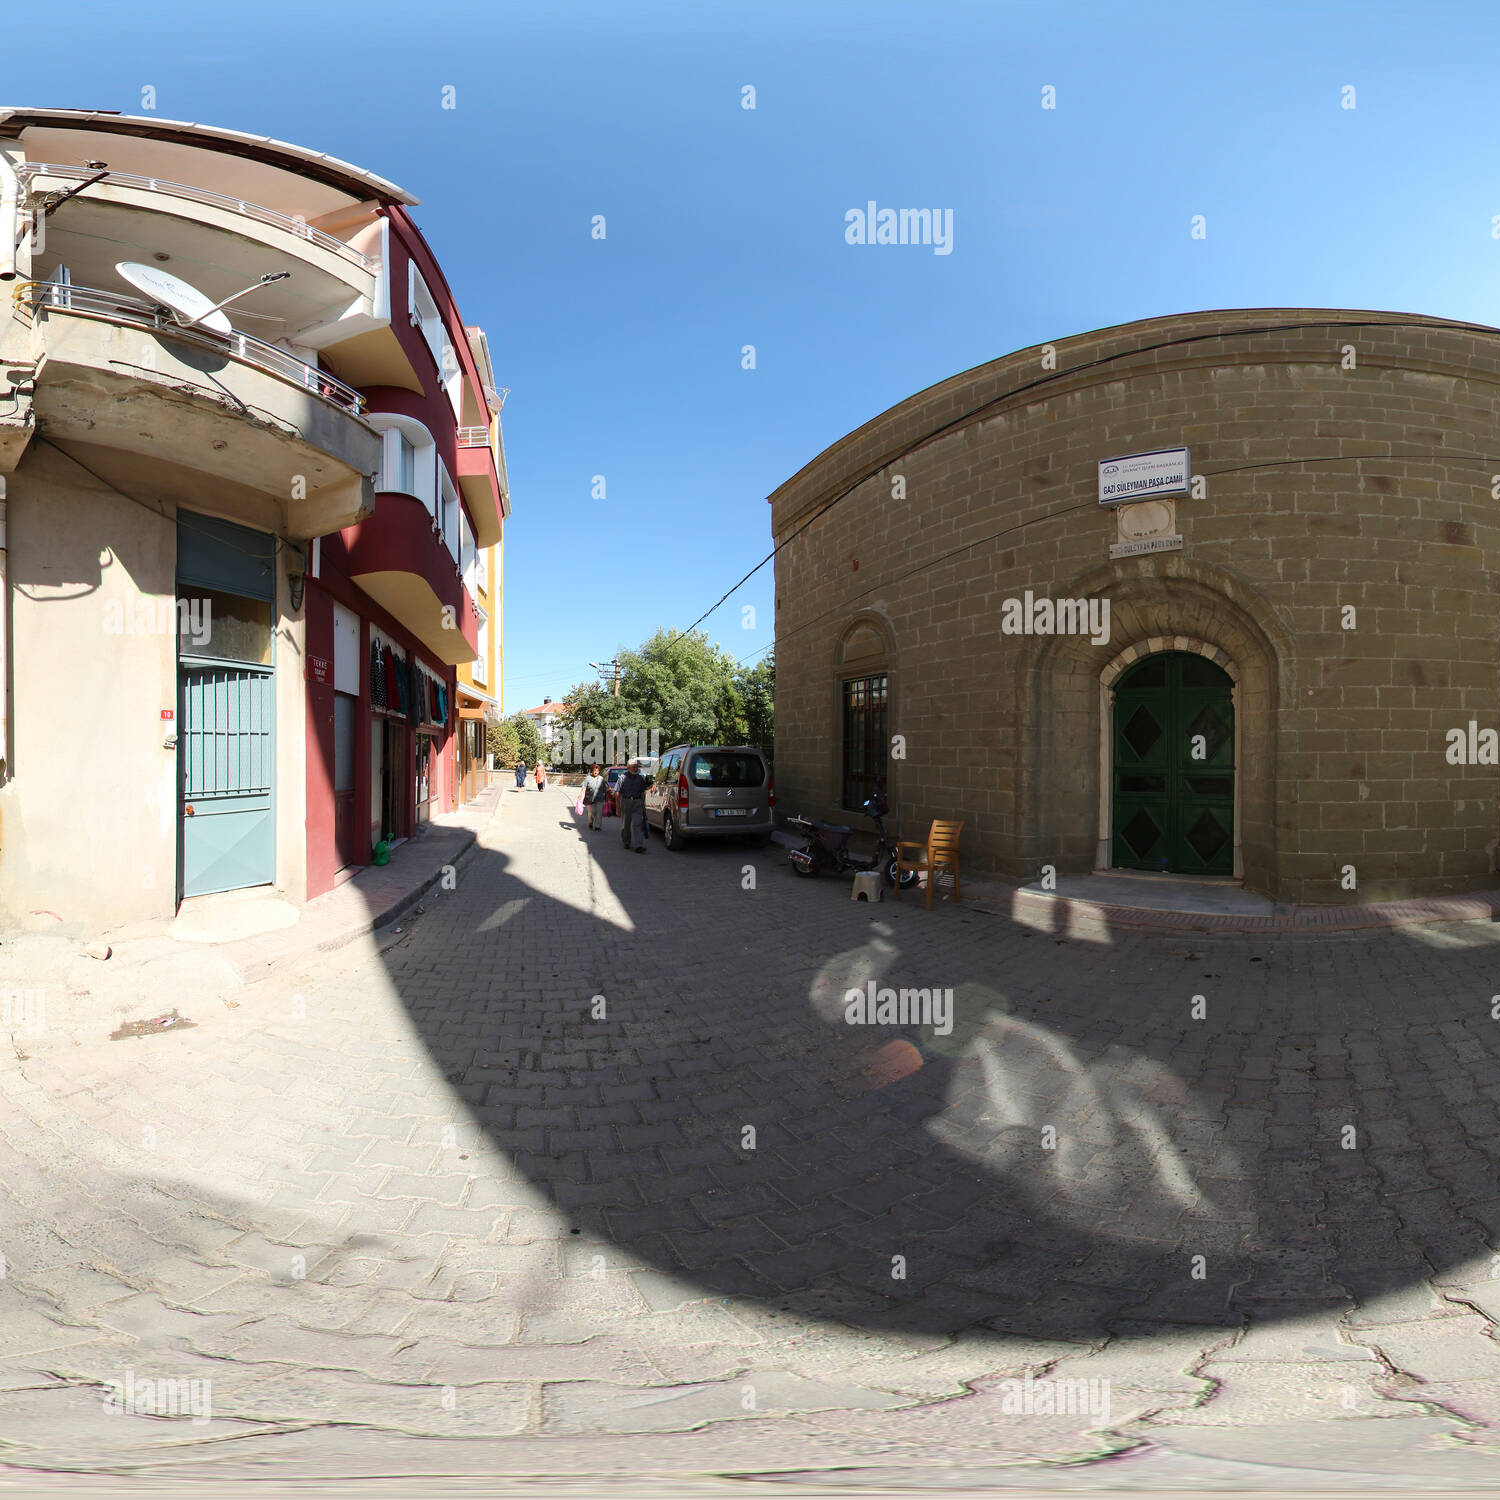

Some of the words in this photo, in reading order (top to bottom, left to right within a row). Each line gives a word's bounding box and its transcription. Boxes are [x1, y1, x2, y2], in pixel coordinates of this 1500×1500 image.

[1103, 482, 1116, 495] GAZİ
[1117, 478, 1148, 493] SÜLEYMAN
[1148, 477, 1164, 489] PAŞA
[313, 658, 327, 669] TEKKE
